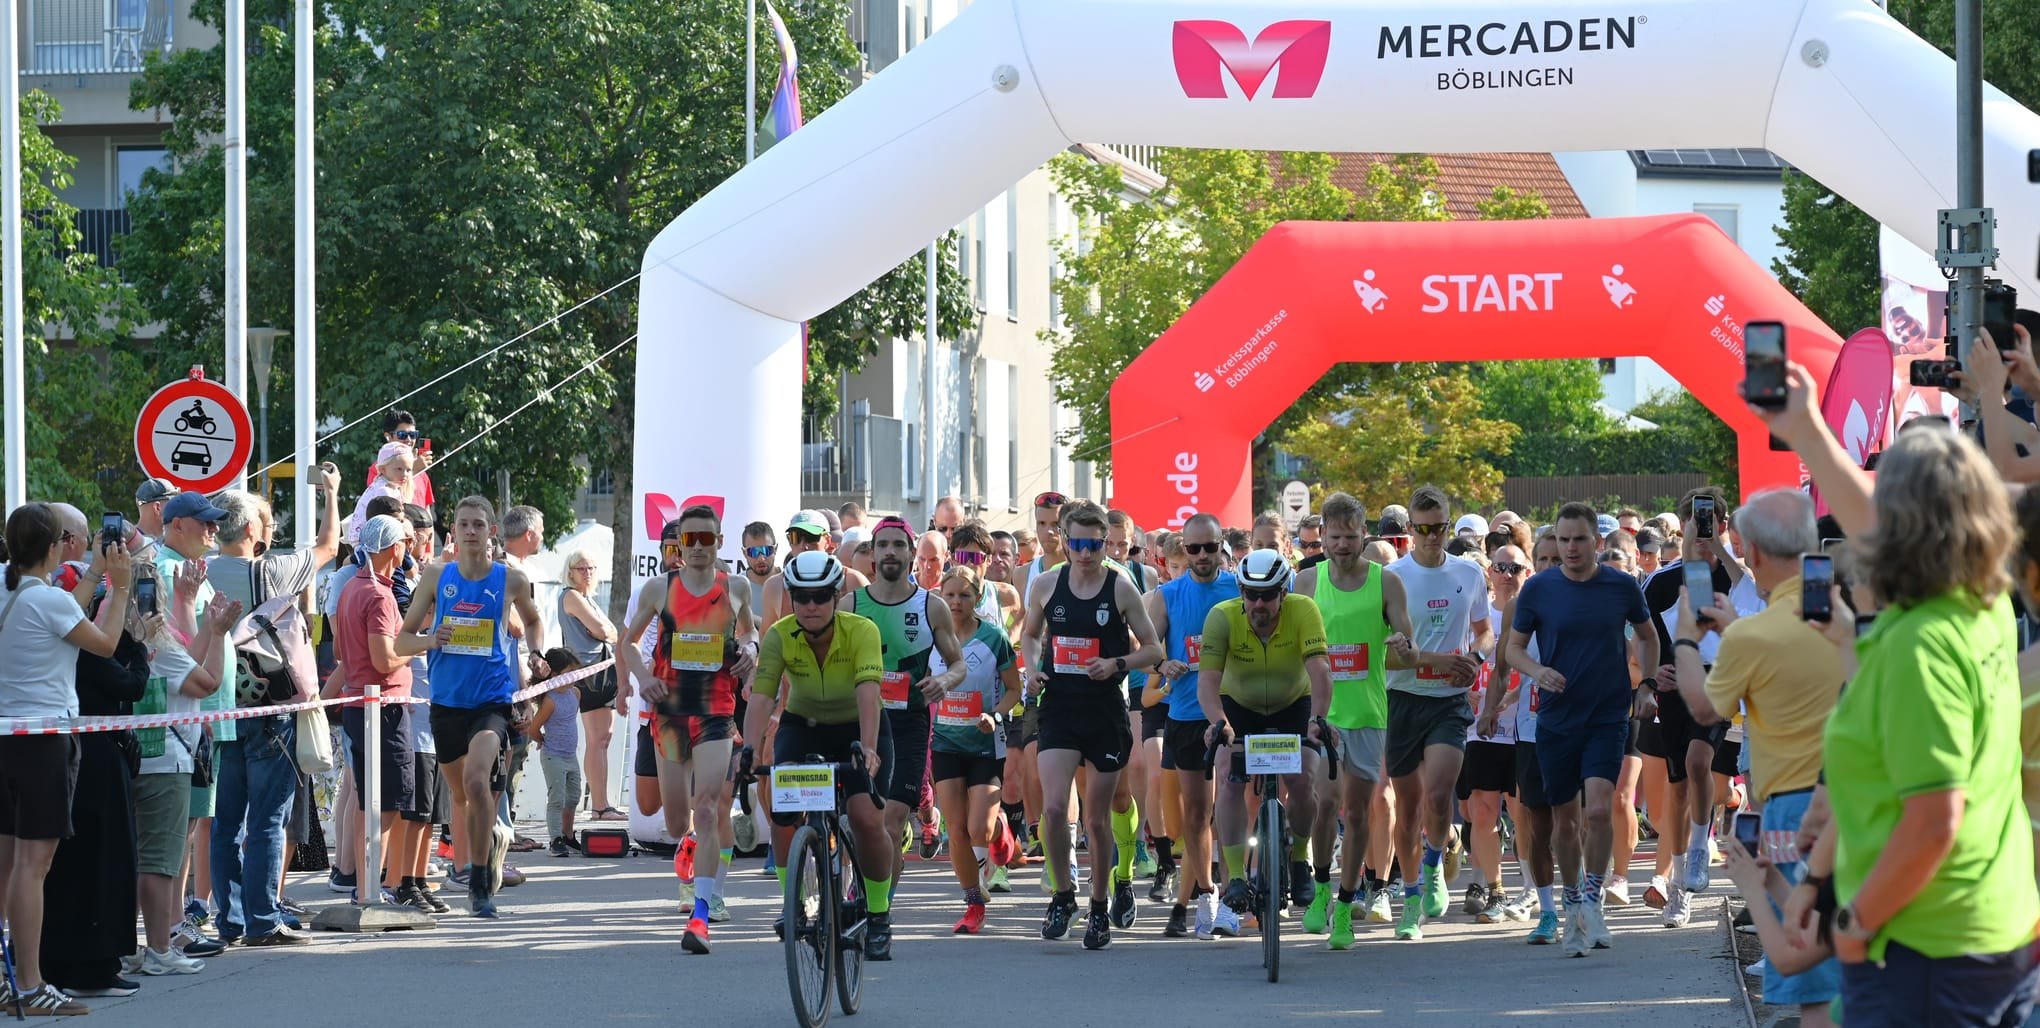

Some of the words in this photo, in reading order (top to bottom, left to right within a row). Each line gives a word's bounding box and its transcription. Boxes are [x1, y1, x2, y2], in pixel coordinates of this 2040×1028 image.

[1437, 67, 1574, 90] BÖBLINGEN
[1421, 272, 1563, 314] START
[1214, 308, 1288, 377] Kreissparkasse
[1226, 340, 1278, 389] Böblingen
